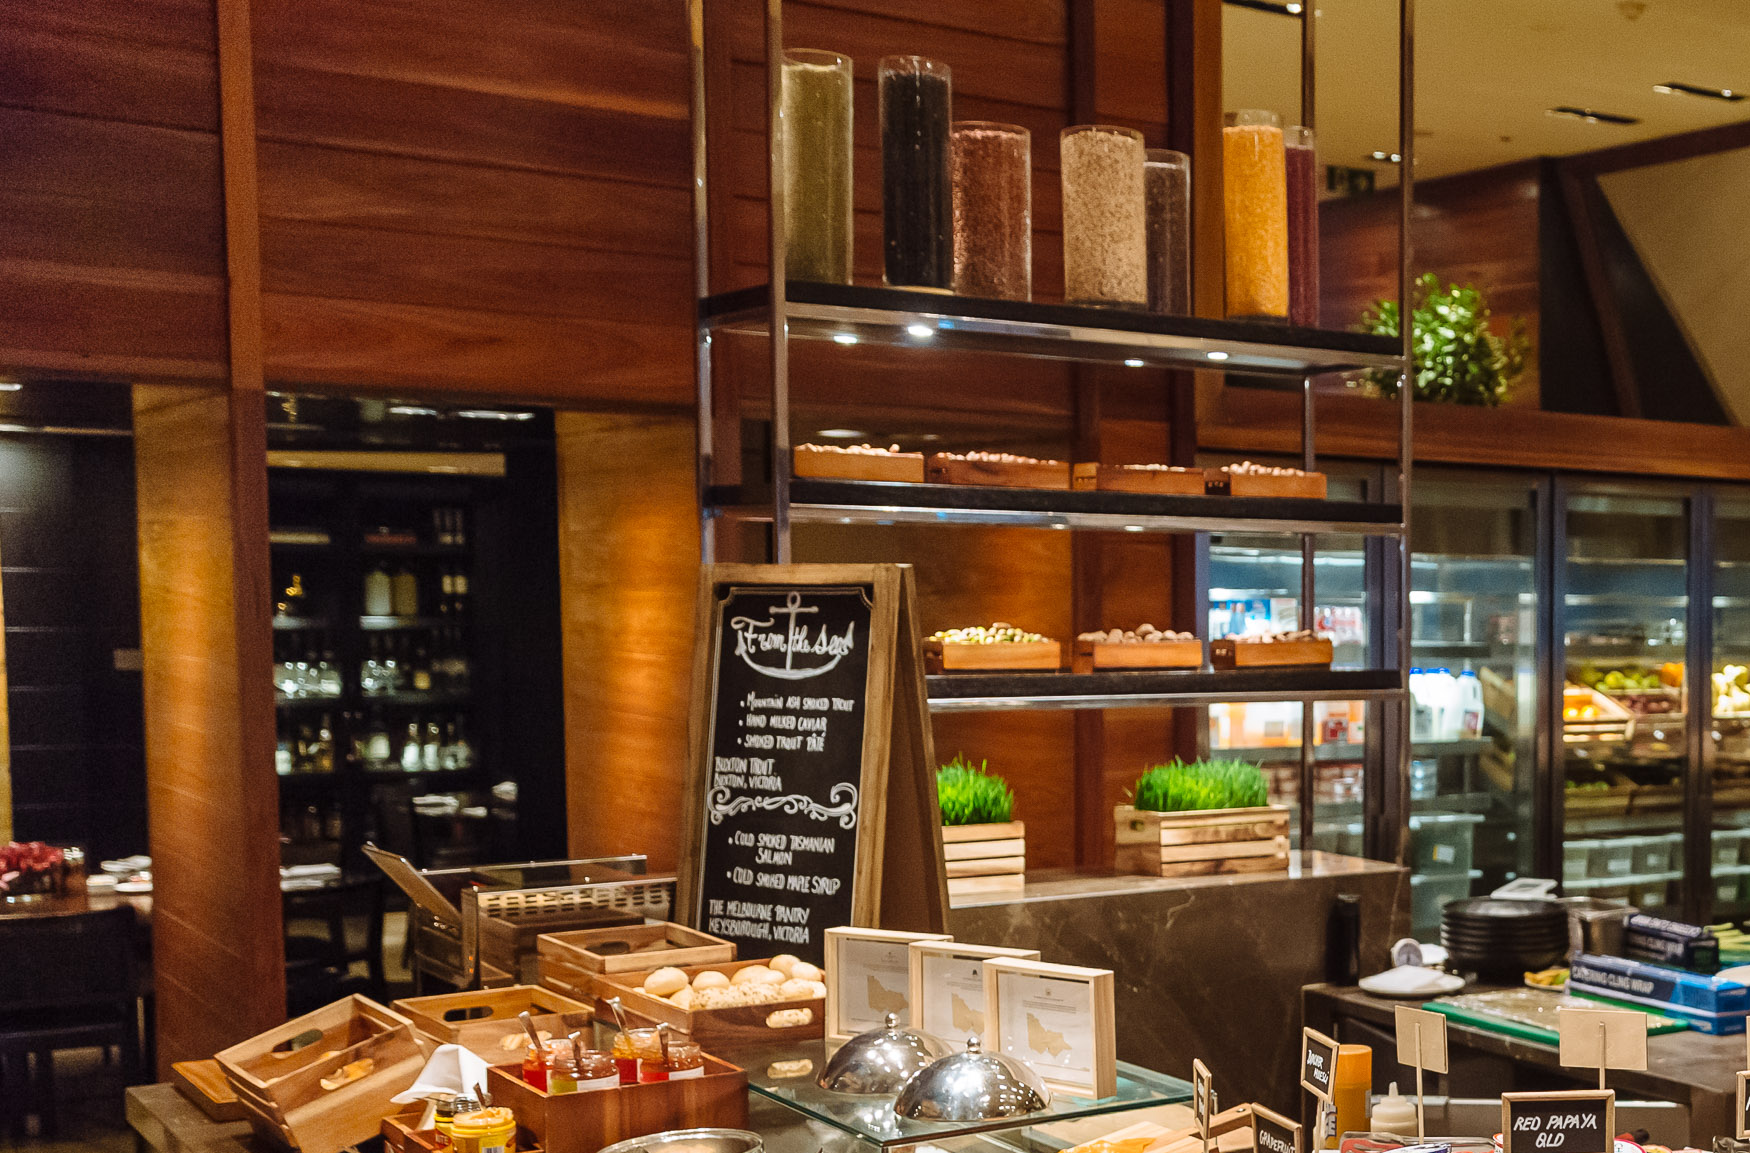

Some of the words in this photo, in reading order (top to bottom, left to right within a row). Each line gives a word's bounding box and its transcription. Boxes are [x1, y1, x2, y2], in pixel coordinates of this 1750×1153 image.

[731, 616, 787, 654] From
[791, 624, 811, 652] the
[786, 695, 801, 710] ASH
[802, 697, 830, 711] SMOKED
[832, 697, 856, 712] TROUT
[746, 713, 767, 729] HAND
[797, 716, 828, 732] CAVIAR
[743, 733, 774, 749] SMOKED
[776, 735, 803, 750] TROUT
[748, 775, 783, 793] VICTORIA
[734, 830, 756, 847] COLD
[756, 833, 787, 850] SMOKED
[789, 834, 836, 854] TASMANIAN
[755, 847, 793, 867] SALMON
[732, 866, 754, 886] COLD
[755, 872, 786, 890] SMOKED
[787, 875, 811, 894] MAPLE
[811, 875, 841, 896] SYRUP
[709, 899, 724, 916] THE
[726, 900, 773, 921] MELBOURNE
[774, 904, 811, 925] PANTRY
[773, 925, 810, 945] VICTORIA
[1571, 965, 1608, 985] CATERING
[1608, 973, 1631, 991] CLING
[1631, 980, 1654, 995] WRAP
[1513, 1116, 1541, 1131] RED
[1545, 1113, 1598, 1130] PAPAYA
[1535, 1132, 1565, 1148] QLD
